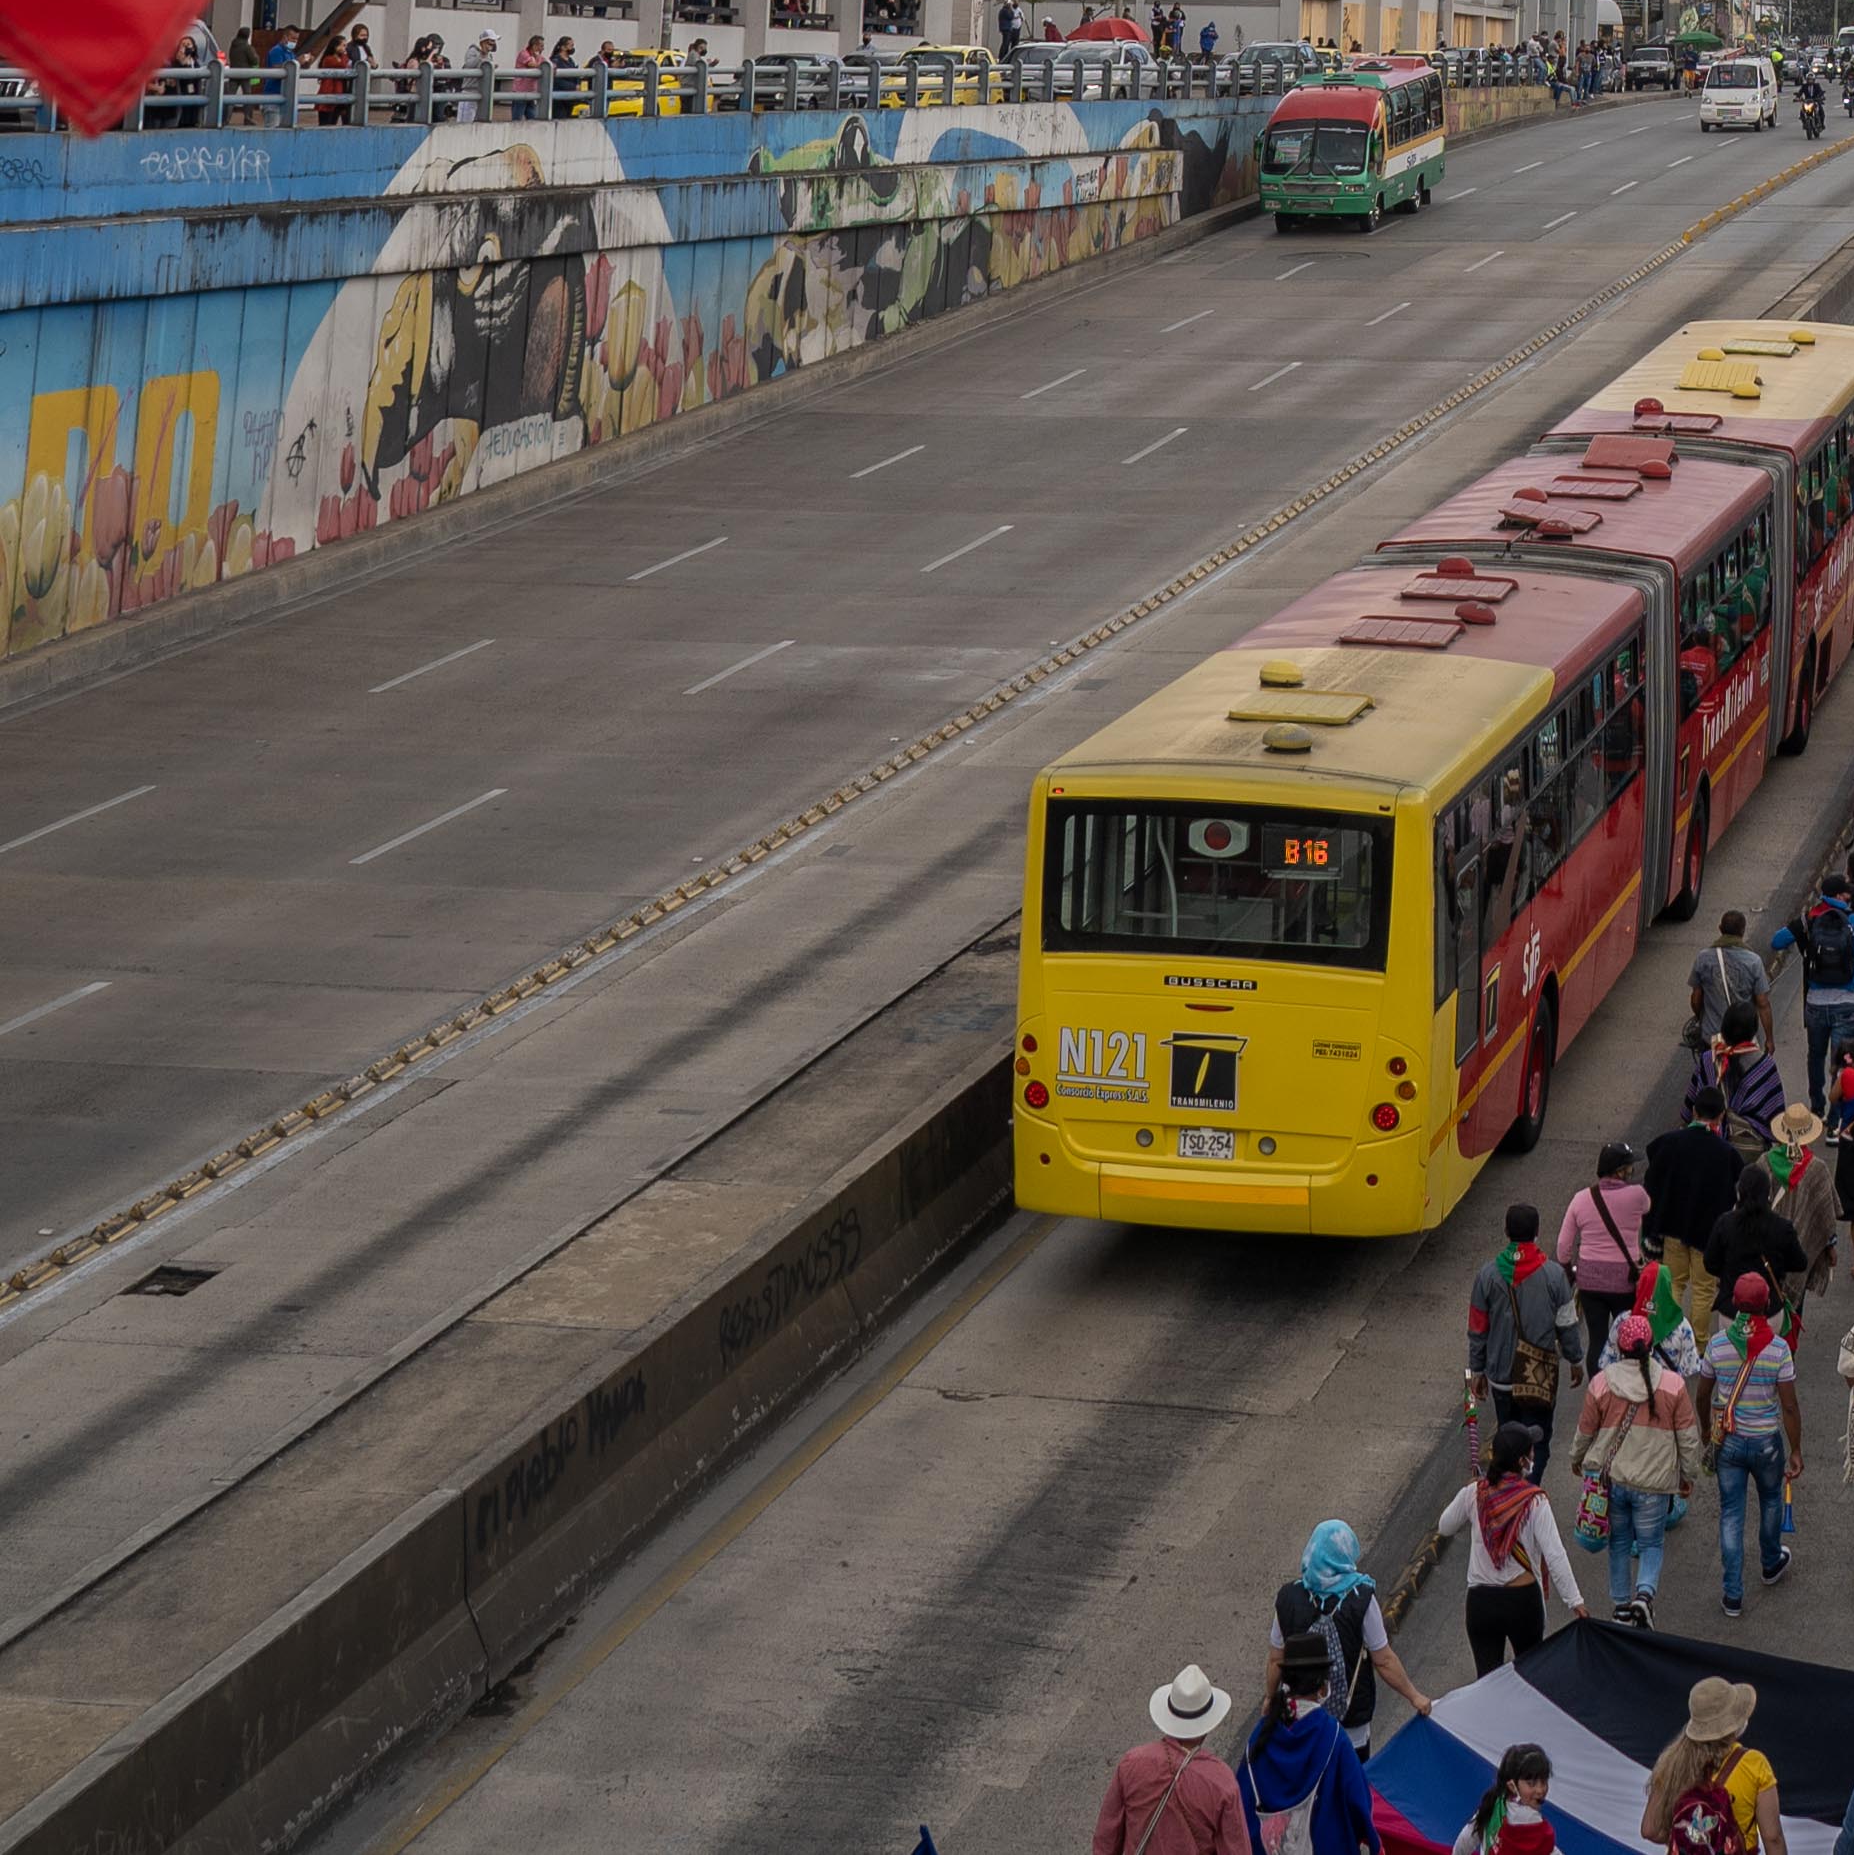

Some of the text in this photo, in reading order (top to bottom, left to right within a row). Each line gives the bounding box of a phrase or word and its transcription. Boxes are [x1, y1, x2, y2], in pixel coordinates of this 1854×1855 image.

[1284, 838, 1328, 865] B16
[1168, 976, 1254, 989] BUSSCAR
[1060, 1027, 1147, 1079] N121
[1056, 1084, 1149, 1102] Consorcio Express S.A.S.
[1172, 1096, 1235, 1109] TRANSMILENIO
